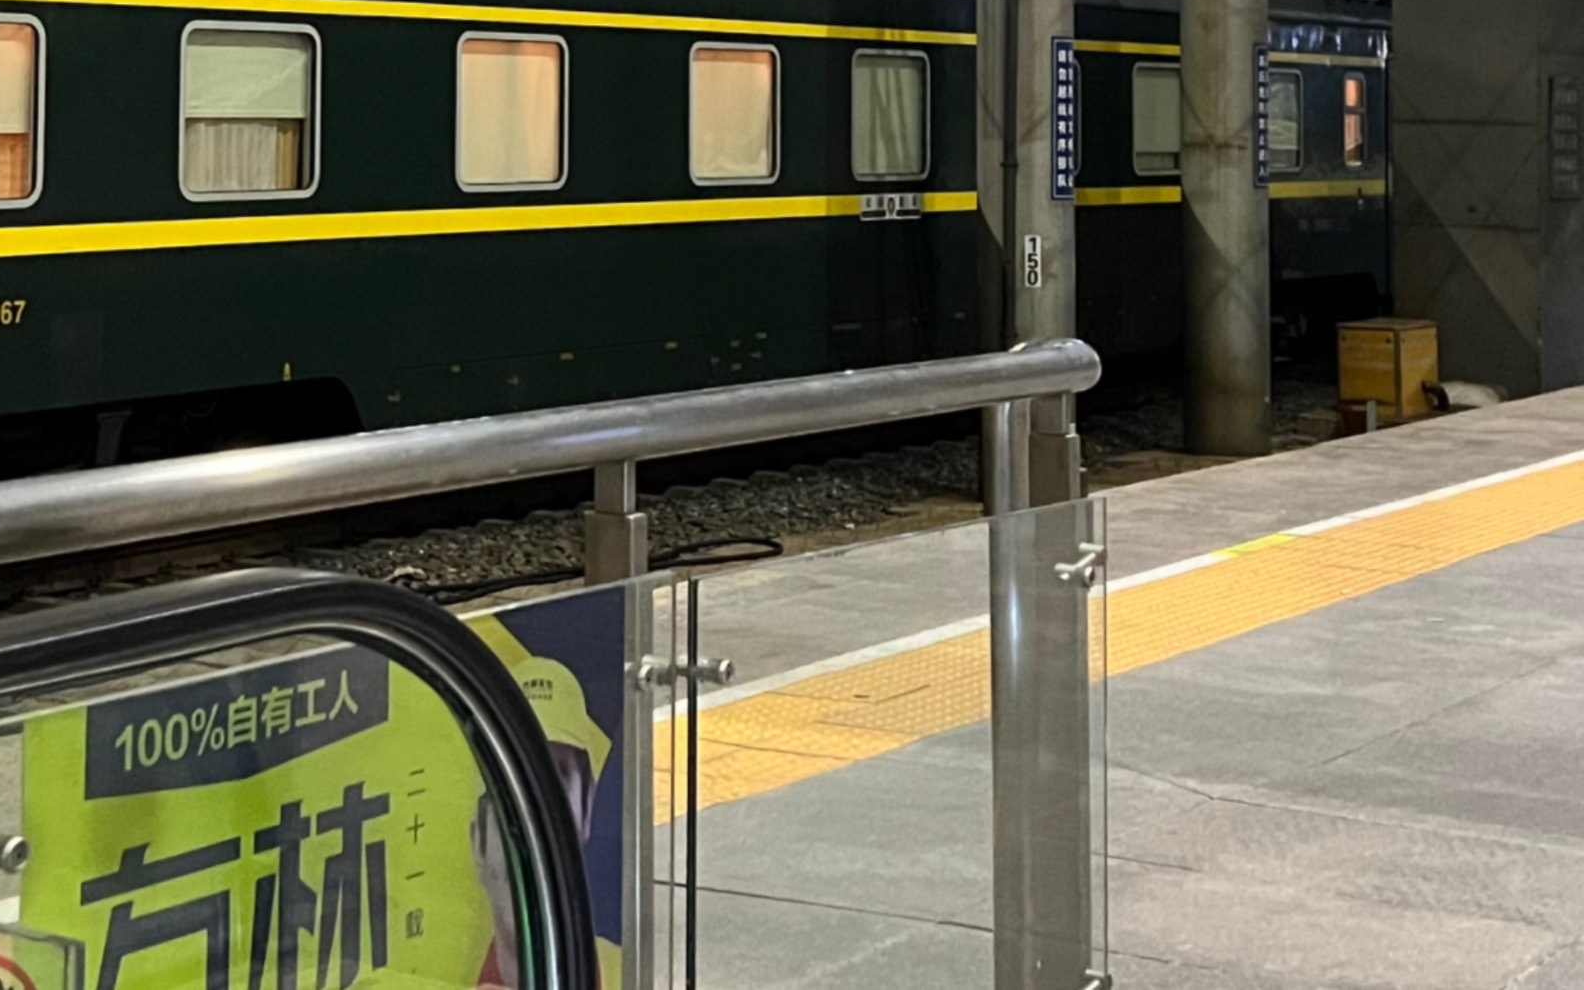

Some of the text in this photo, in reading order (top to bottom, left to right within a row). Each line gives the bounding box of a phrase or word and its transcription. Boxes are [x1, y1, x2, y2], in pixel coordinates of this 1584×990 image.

[1027, 236, 1039, 286] 150
[115, 669, 359, 772] 100%自有工人
